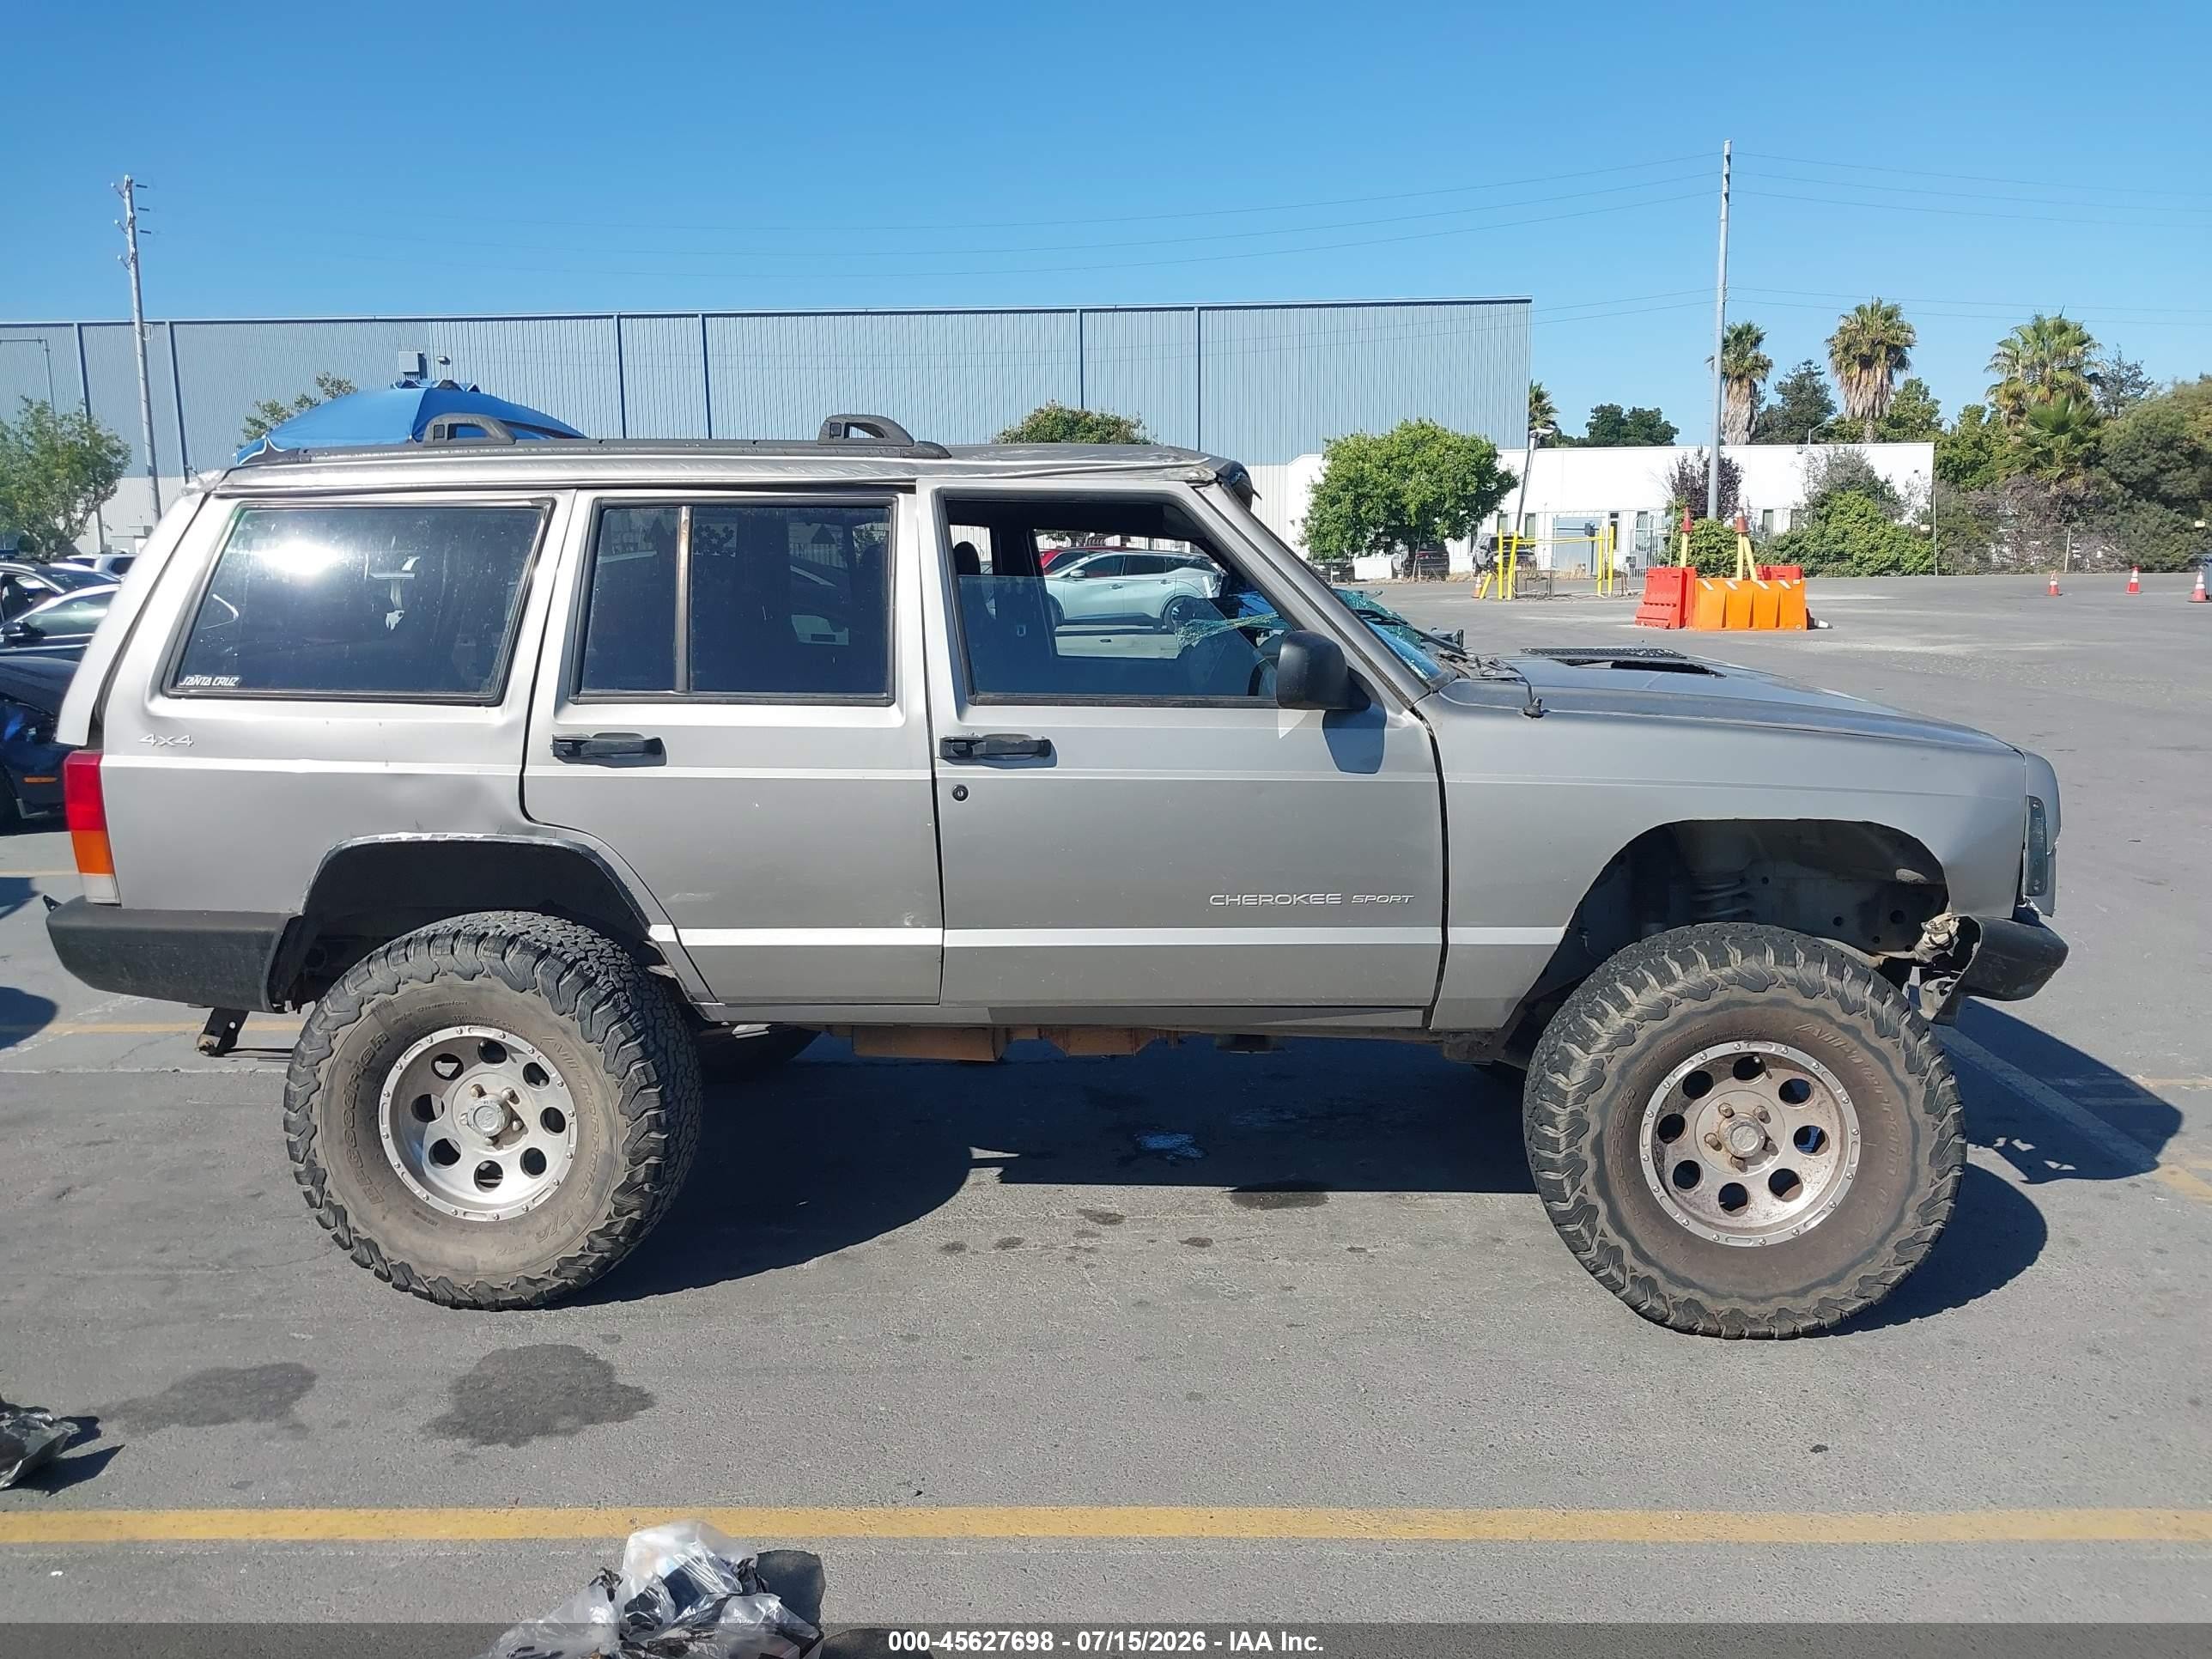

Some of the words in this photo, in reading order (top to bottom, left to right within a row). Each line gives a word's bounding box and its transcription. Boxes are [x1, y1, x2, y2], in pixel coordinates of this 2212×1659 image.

[179, 674, 213, 686] SANTA
[212, 676, 240, 686] CRUZ
[1209, 894, 1343, 906] CHEROKEE
[1352, 895, 1415, 904] SPORT
